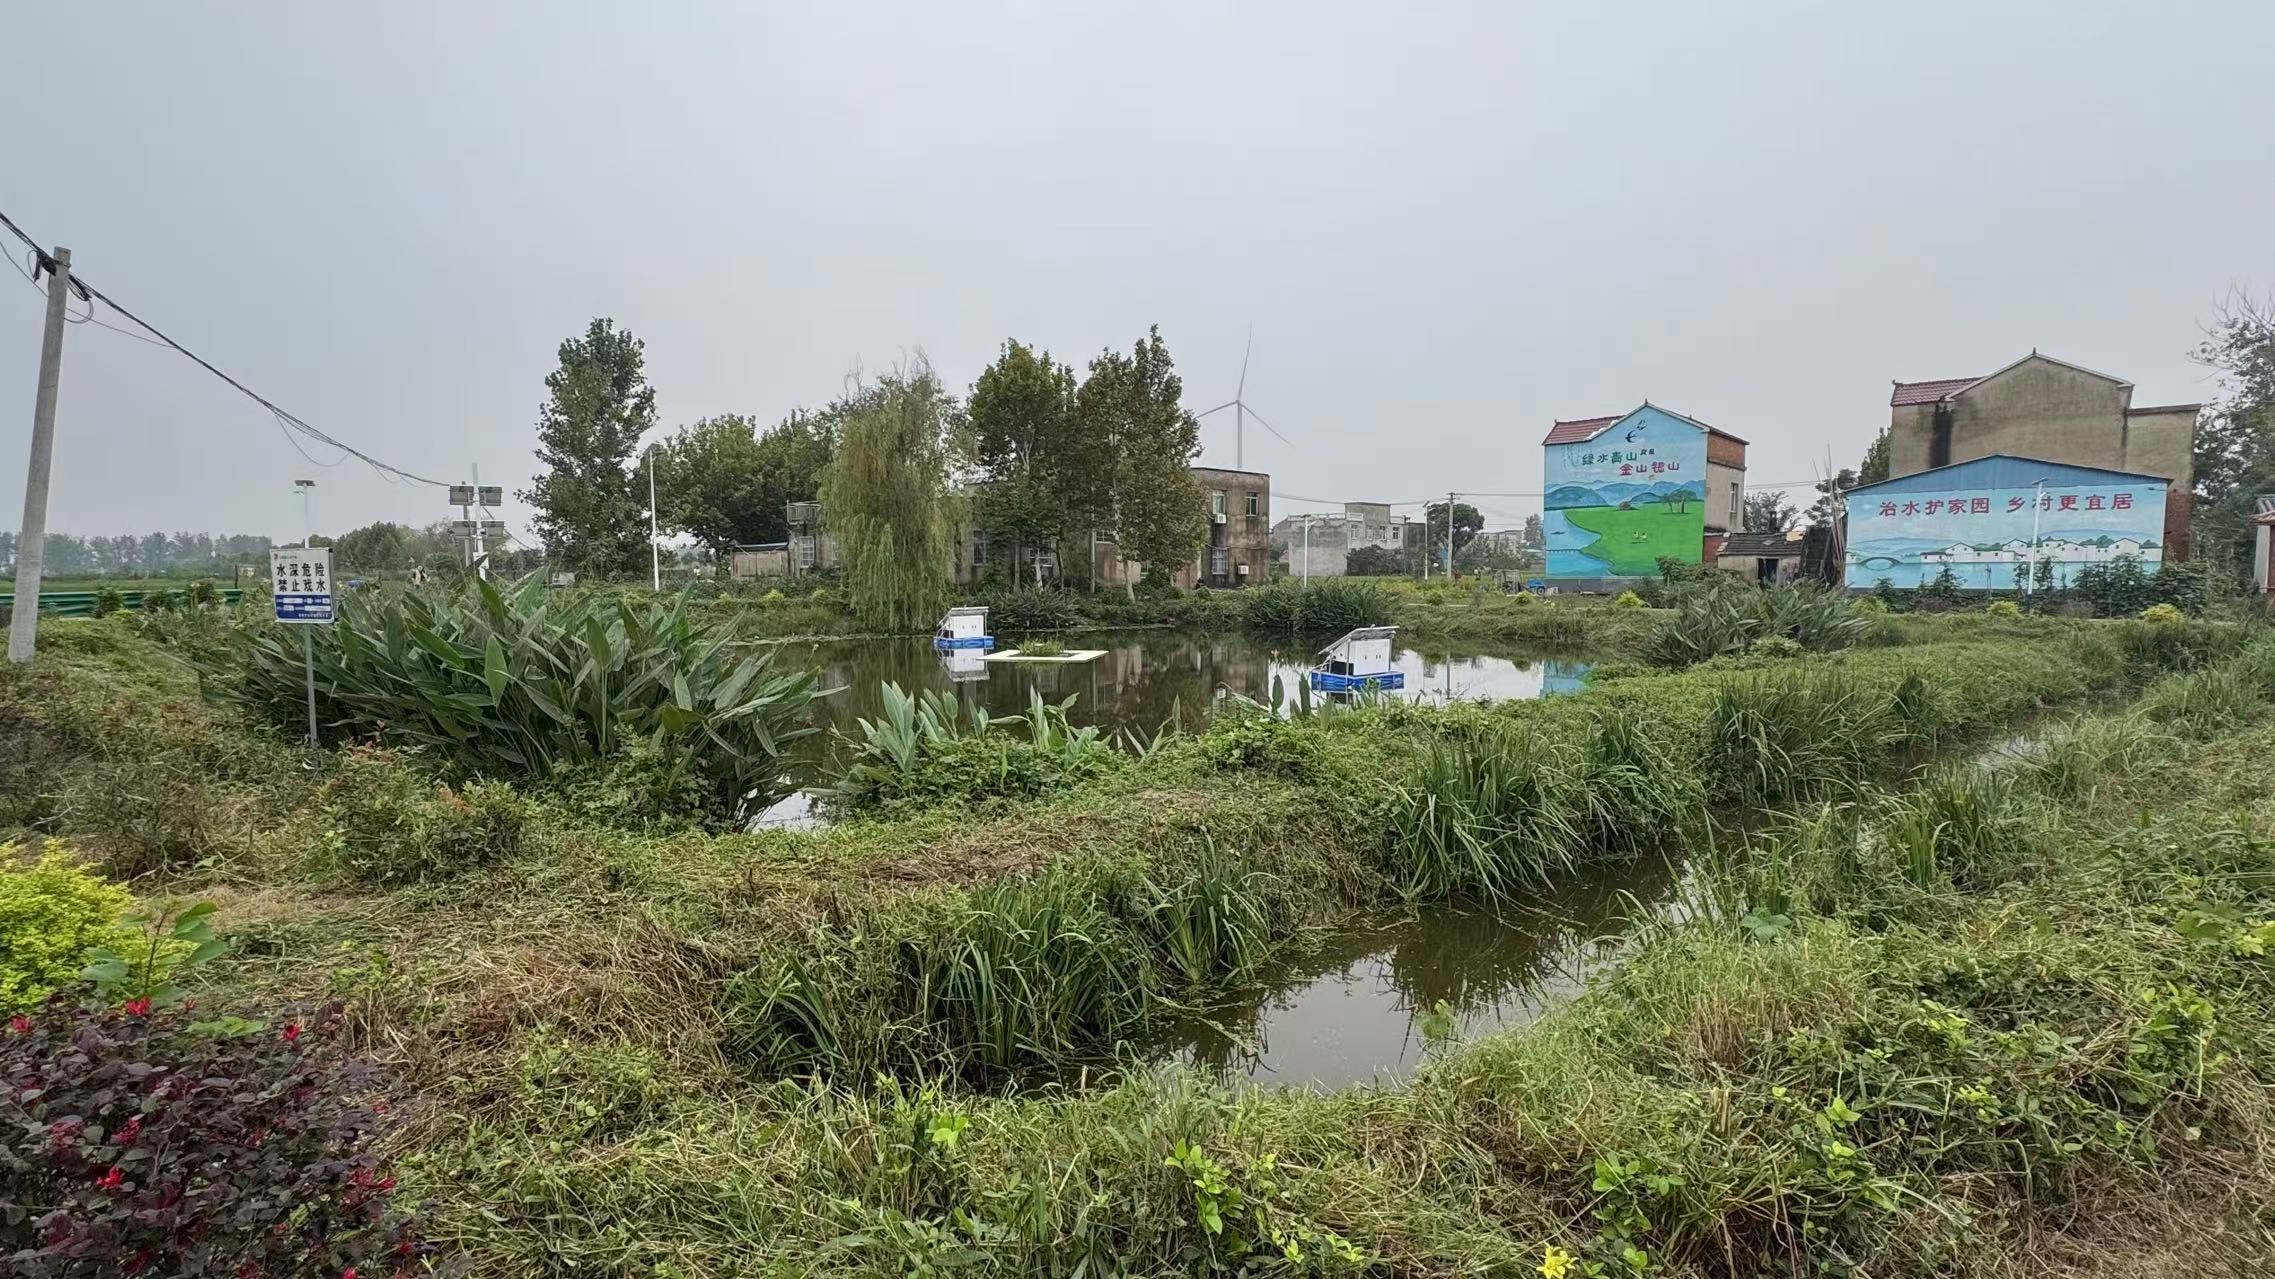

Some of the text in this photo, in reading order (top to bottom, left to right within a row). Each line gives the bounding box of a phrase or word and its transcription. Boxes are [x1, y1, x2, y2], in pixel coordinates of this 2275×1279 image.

[1582, 452, 1637, 466] 绿水青山
[1619, 461, 1680, 476] 金山银山
[1880, 493, 2135, 517] 治水护家园 乡村更宜居
[276, 562, 325, 577] 水深危险
[278, 578, 326, 592] 禁止戏水
